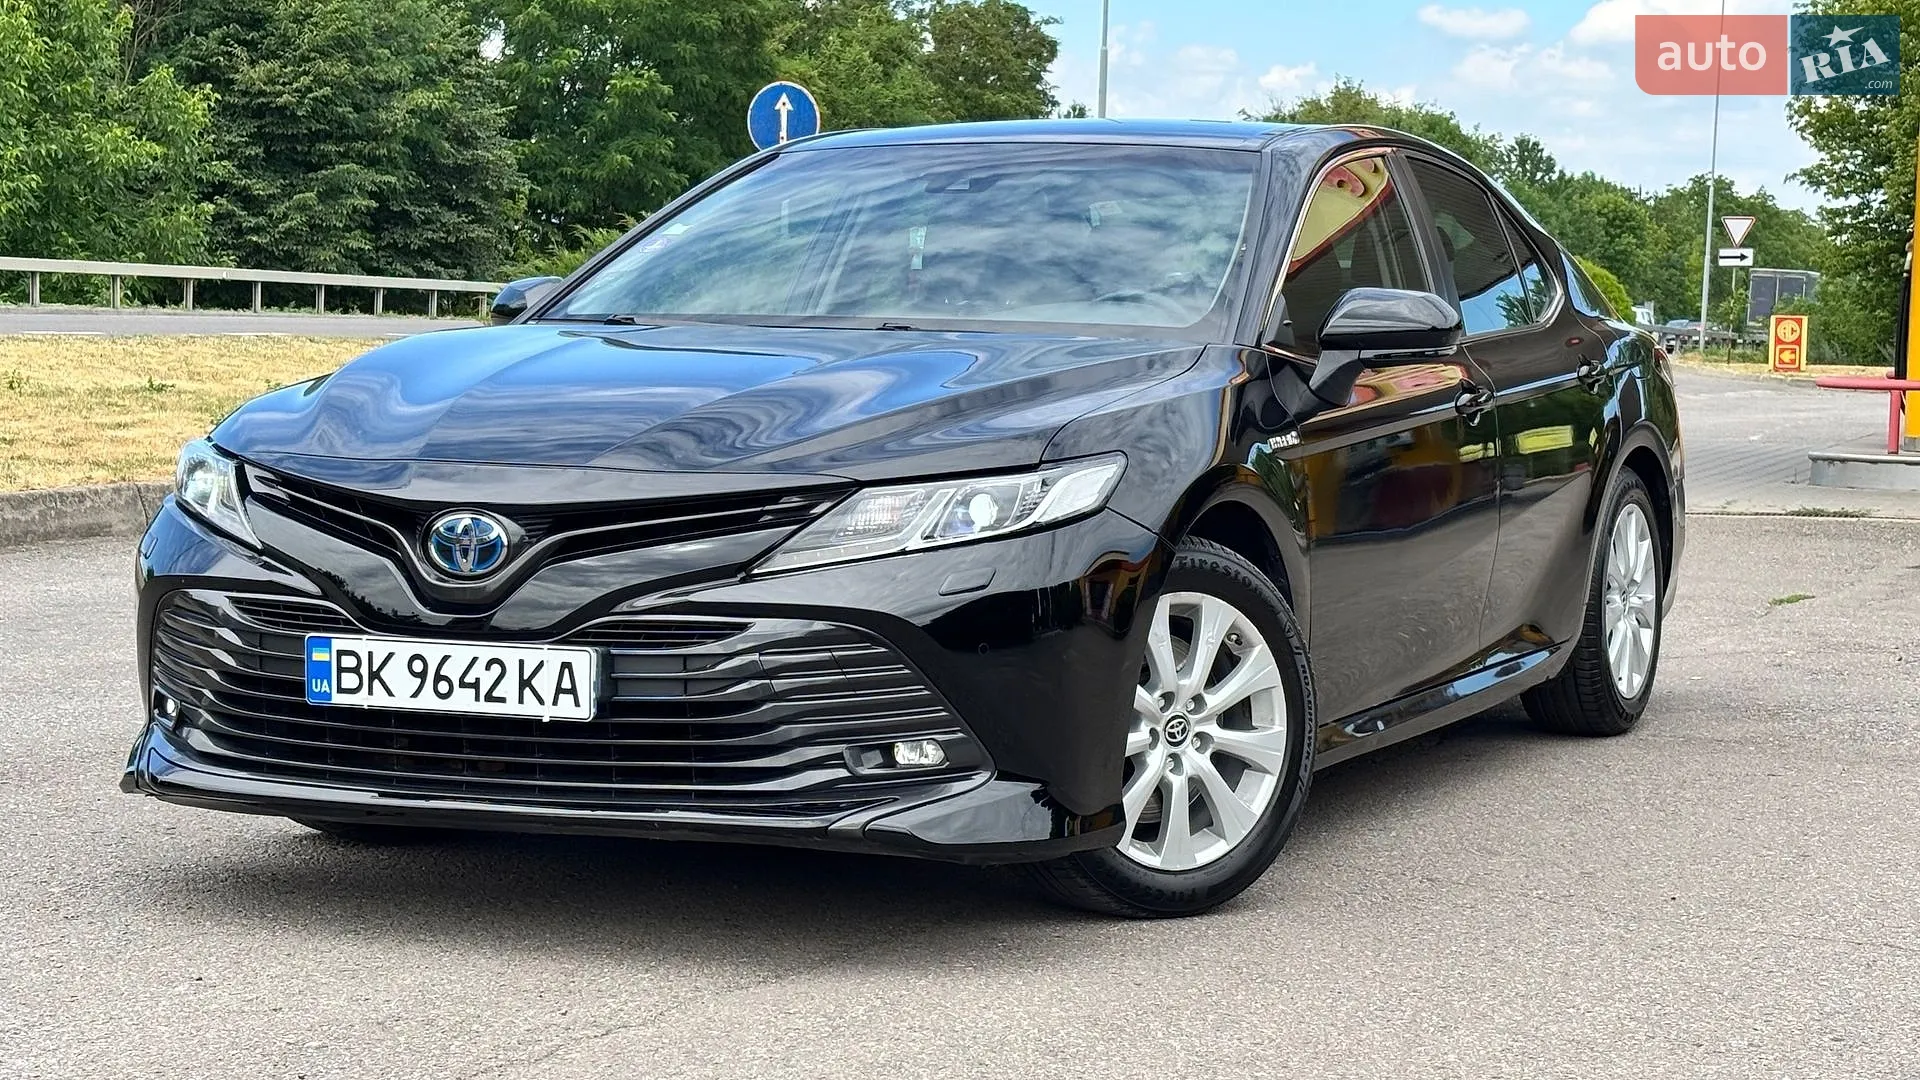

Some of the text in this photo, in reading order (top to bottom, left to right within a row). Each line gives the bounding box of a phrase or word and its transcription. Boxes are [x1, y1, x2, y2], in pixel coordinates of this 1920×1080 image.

[312, 678, 331, 694] UA
[336, 649, 581, 708] BK 9642 KA
